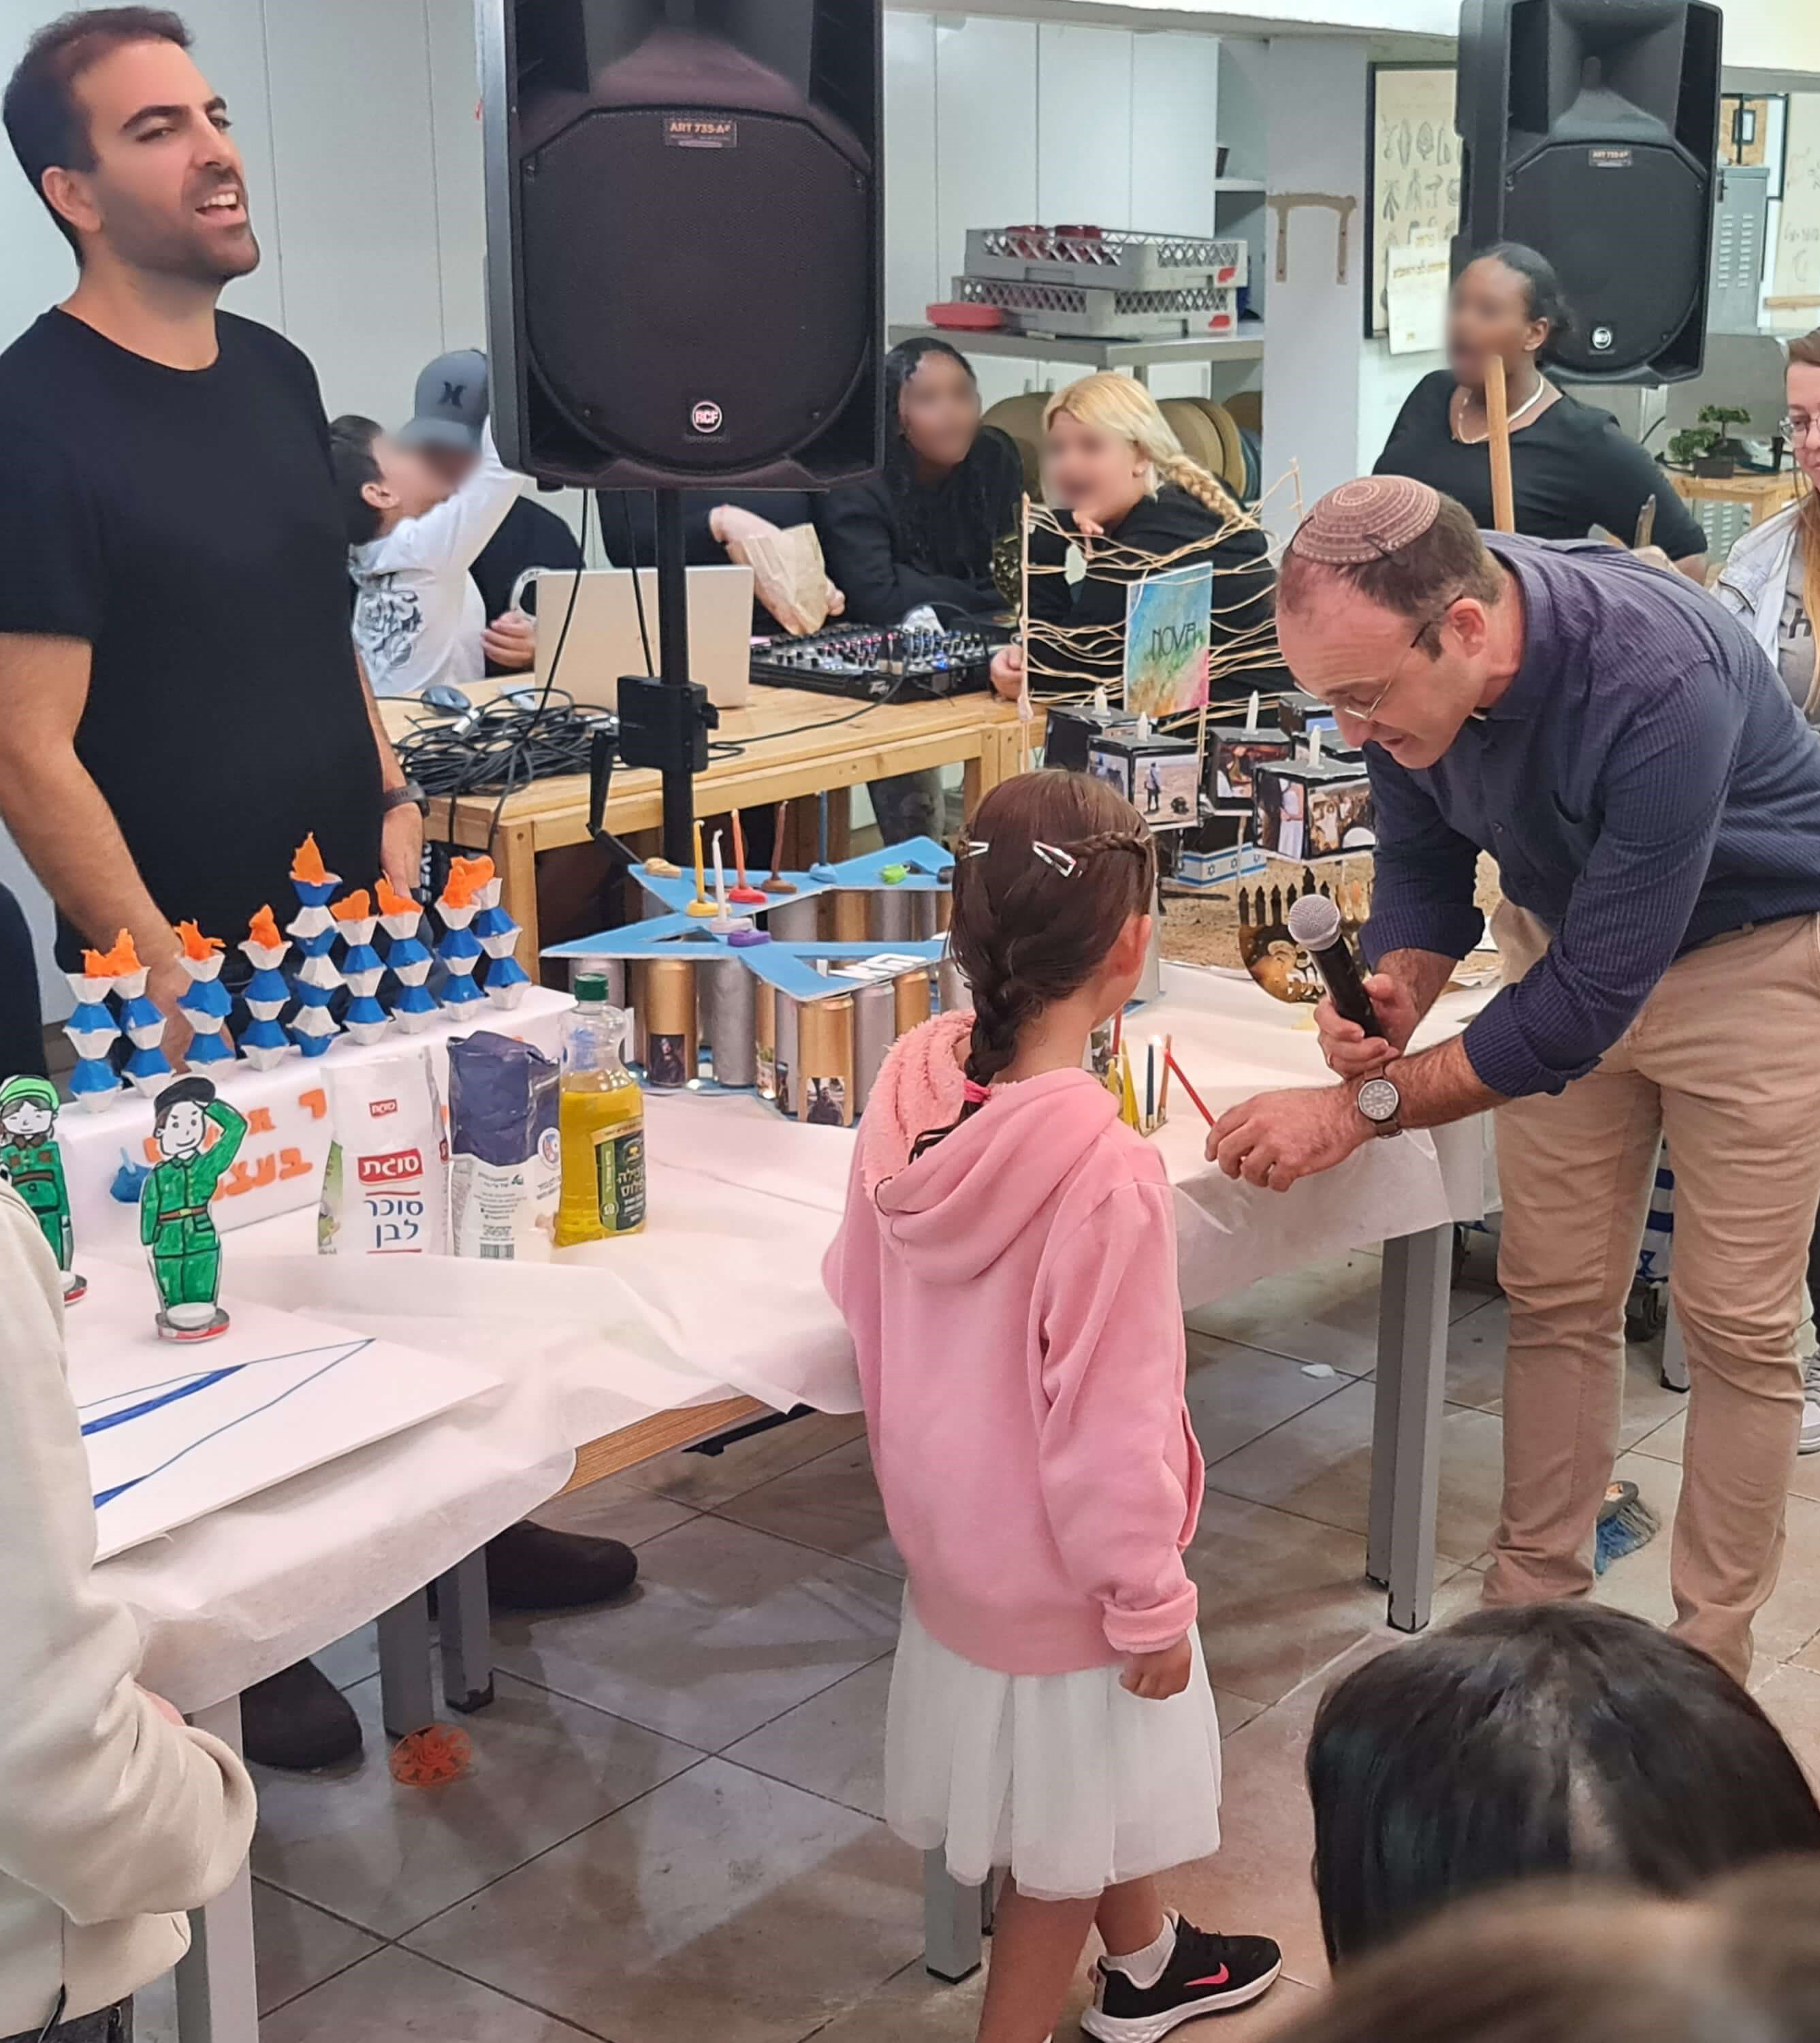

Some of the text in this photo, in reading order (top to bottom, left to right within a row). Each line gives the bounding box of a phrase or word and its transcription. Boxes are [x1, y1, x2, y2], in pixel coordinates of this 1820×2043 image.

[670, 122, 692, 132] ART
[695, 410, 719, 424] RCF
[1152, 621, 1196, 660] NOVA
[363, 1155, 420, 1177] סוגת
[363, 1199, 424, 1217] סוכר
[377, 1219, 419, 1248] לבן
